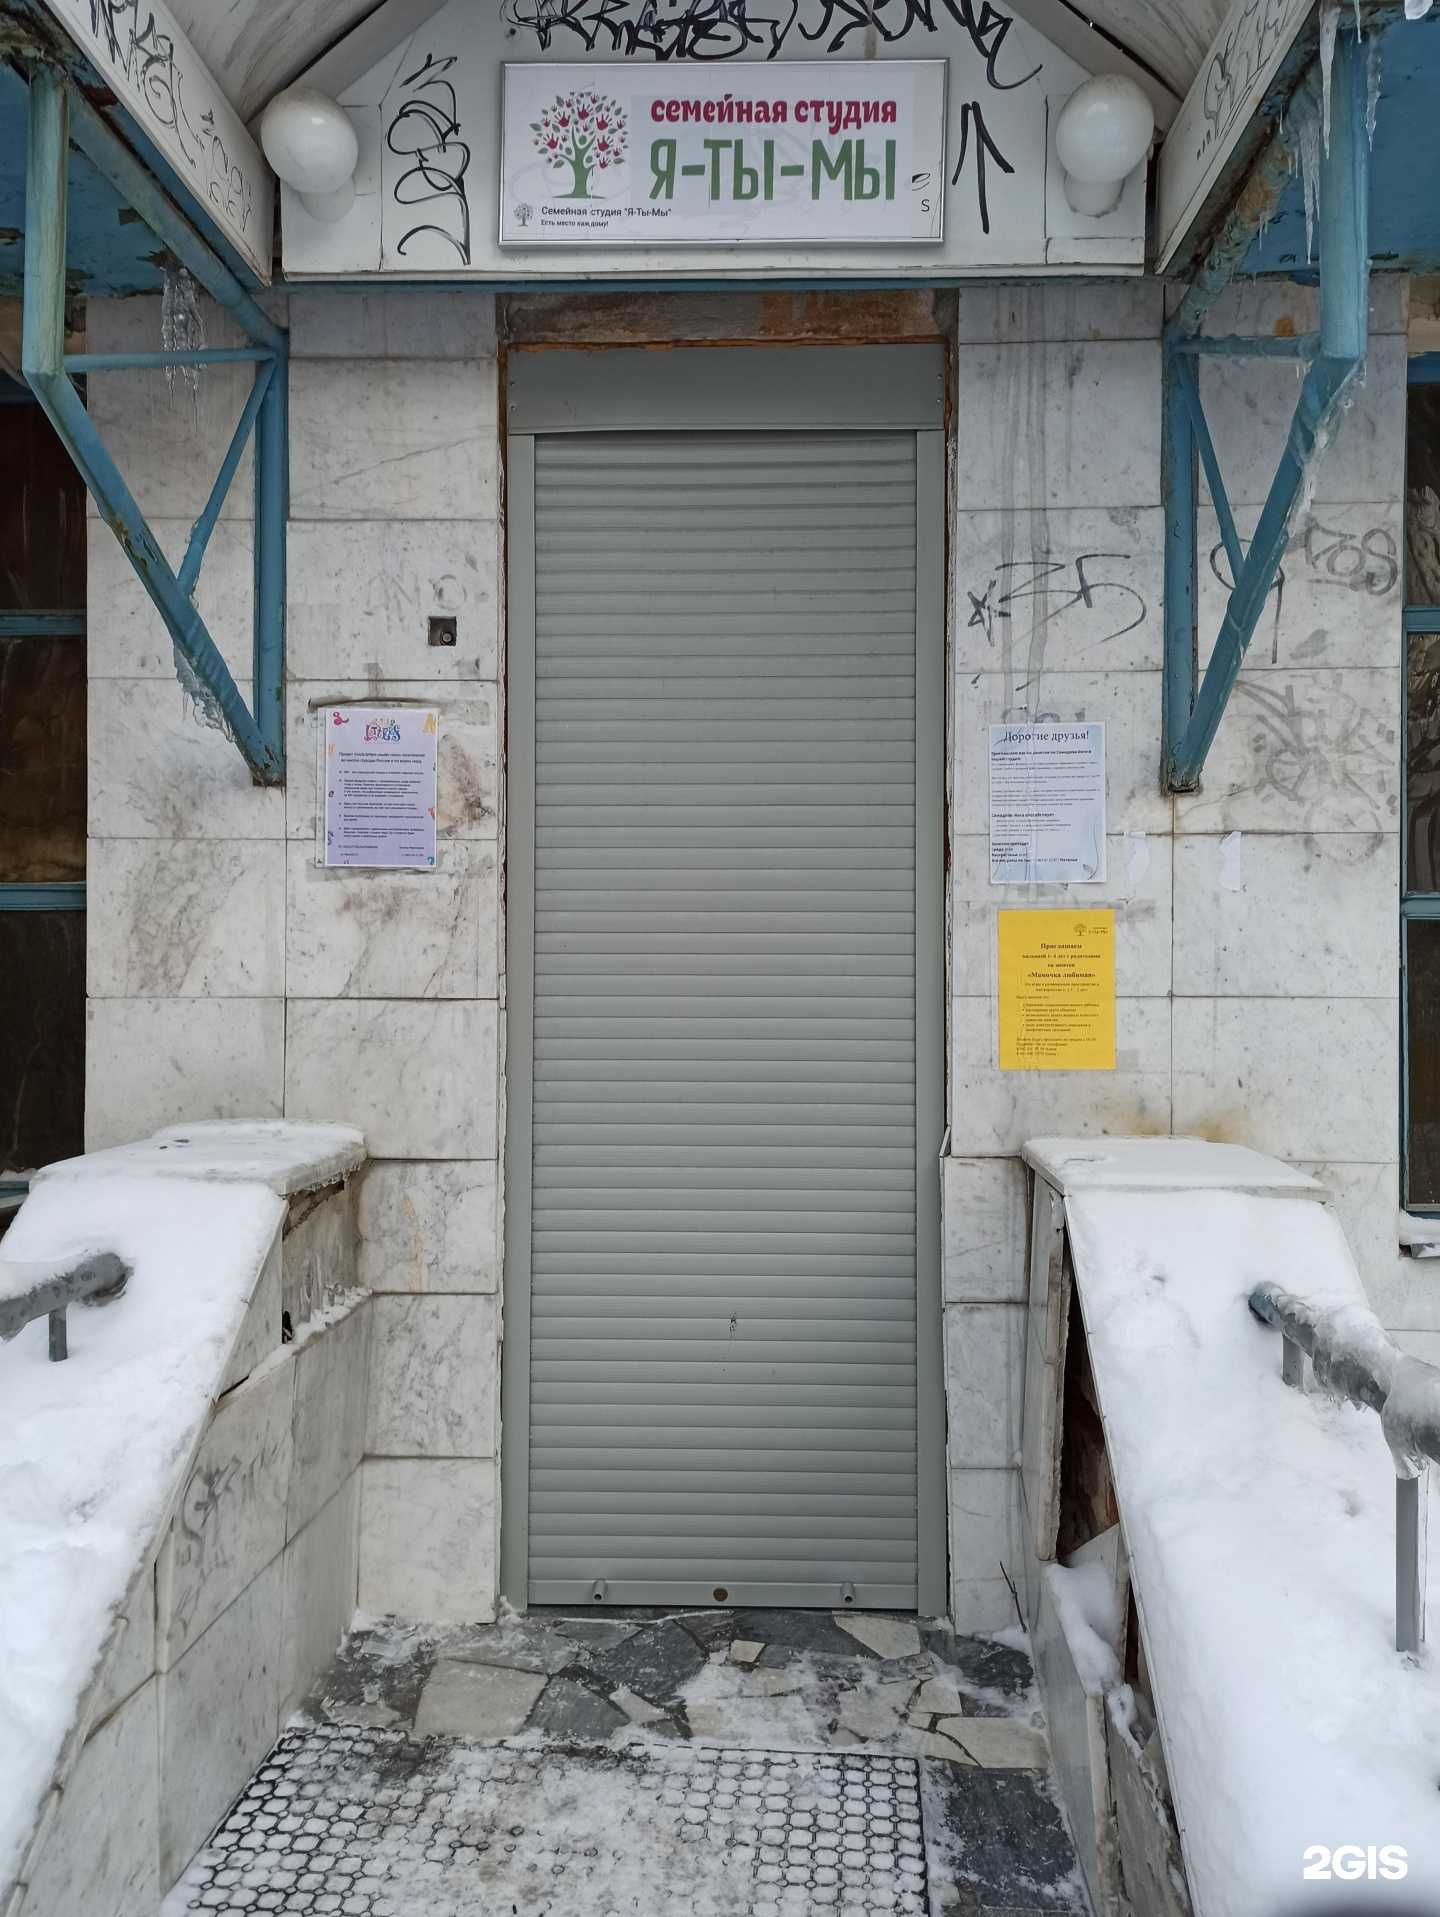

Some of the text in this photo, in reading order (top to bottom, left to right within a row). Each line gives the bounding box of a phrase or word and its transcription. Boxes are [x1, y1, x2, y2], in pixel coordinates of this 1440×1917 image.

[650, 94, 897, 135] семейная студия
[649, 138, 896, 201] Я-ТЫ-МЫ
[541, 206, 588, 216] Семейная
[590, 208, 622, 218] студия
[541, 219, 555, 227] Есть
[1051, 730, 1089, 743] друзья!
